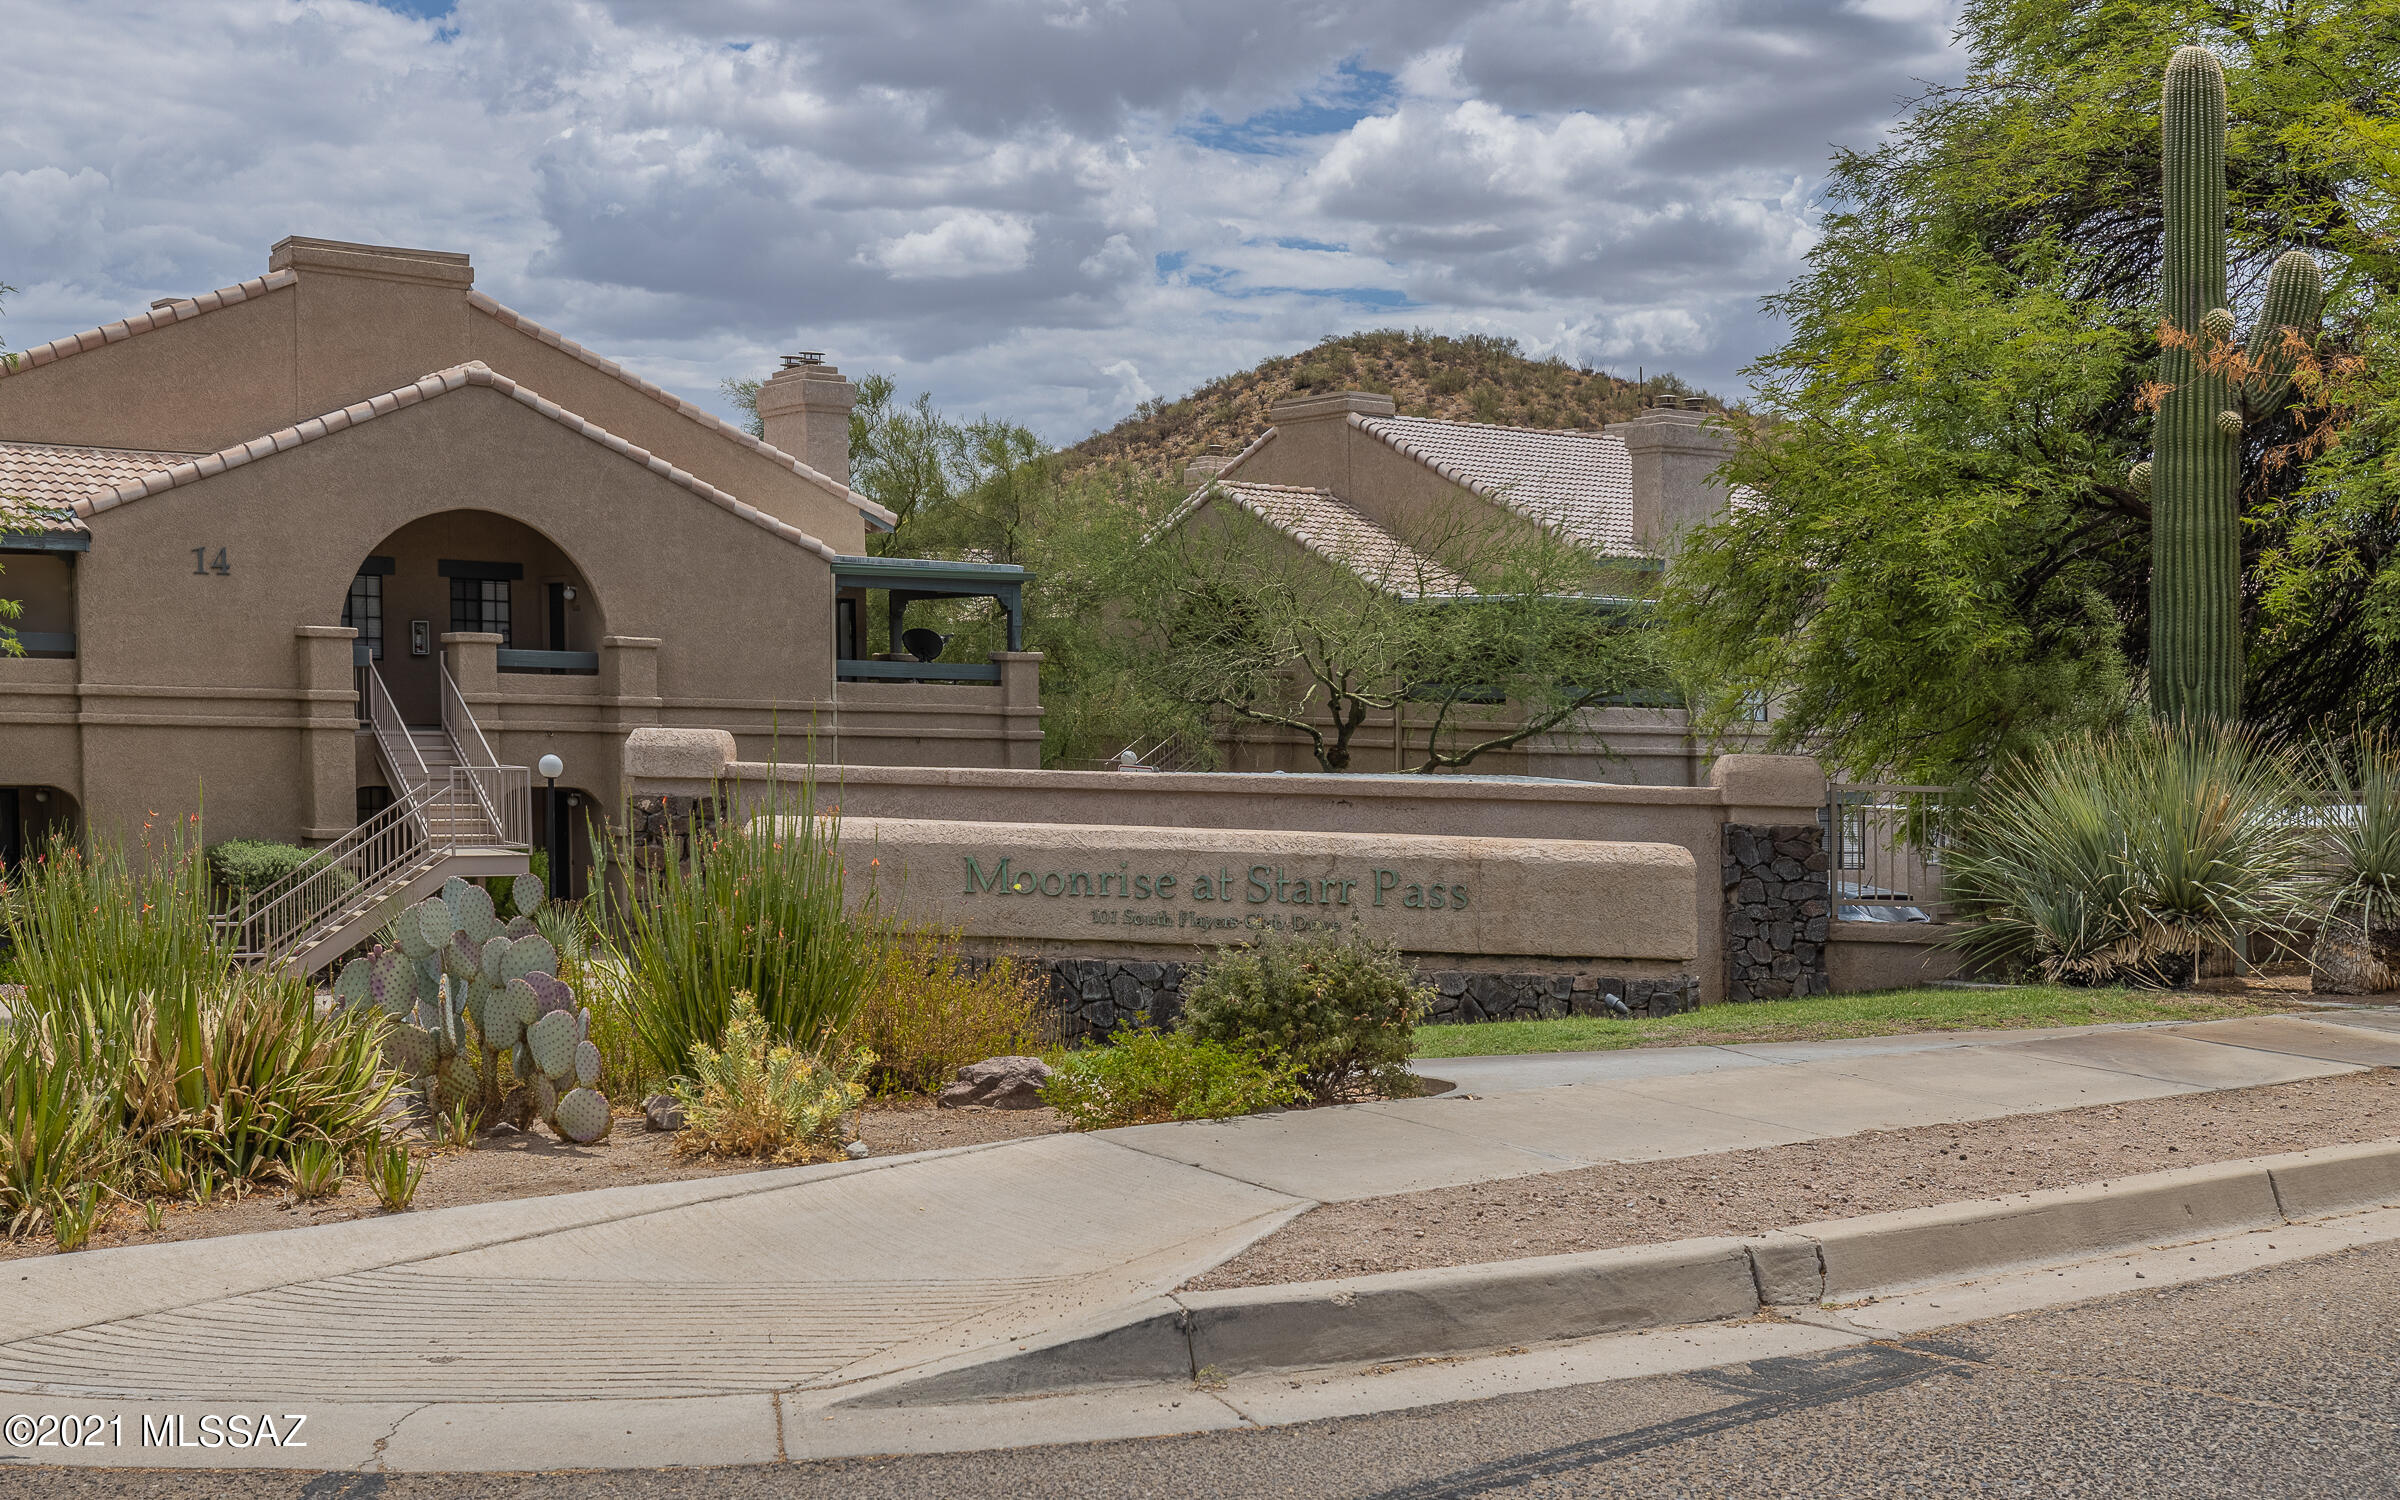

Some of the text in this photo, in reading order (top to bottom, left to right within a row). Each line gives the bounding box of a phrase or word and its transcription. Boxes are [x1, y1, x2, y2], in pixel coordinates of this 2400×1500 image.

[191, 546, 230, 576] 14
[963, 855, 1469, 909] Moonrise at Starr Pass
[1091, 909, 1118, 924] 101
[1123, 909, 1173, 927] South
[1179, 911, 1238, 932] Players
[1292, 914, 1342, 932] Drve
